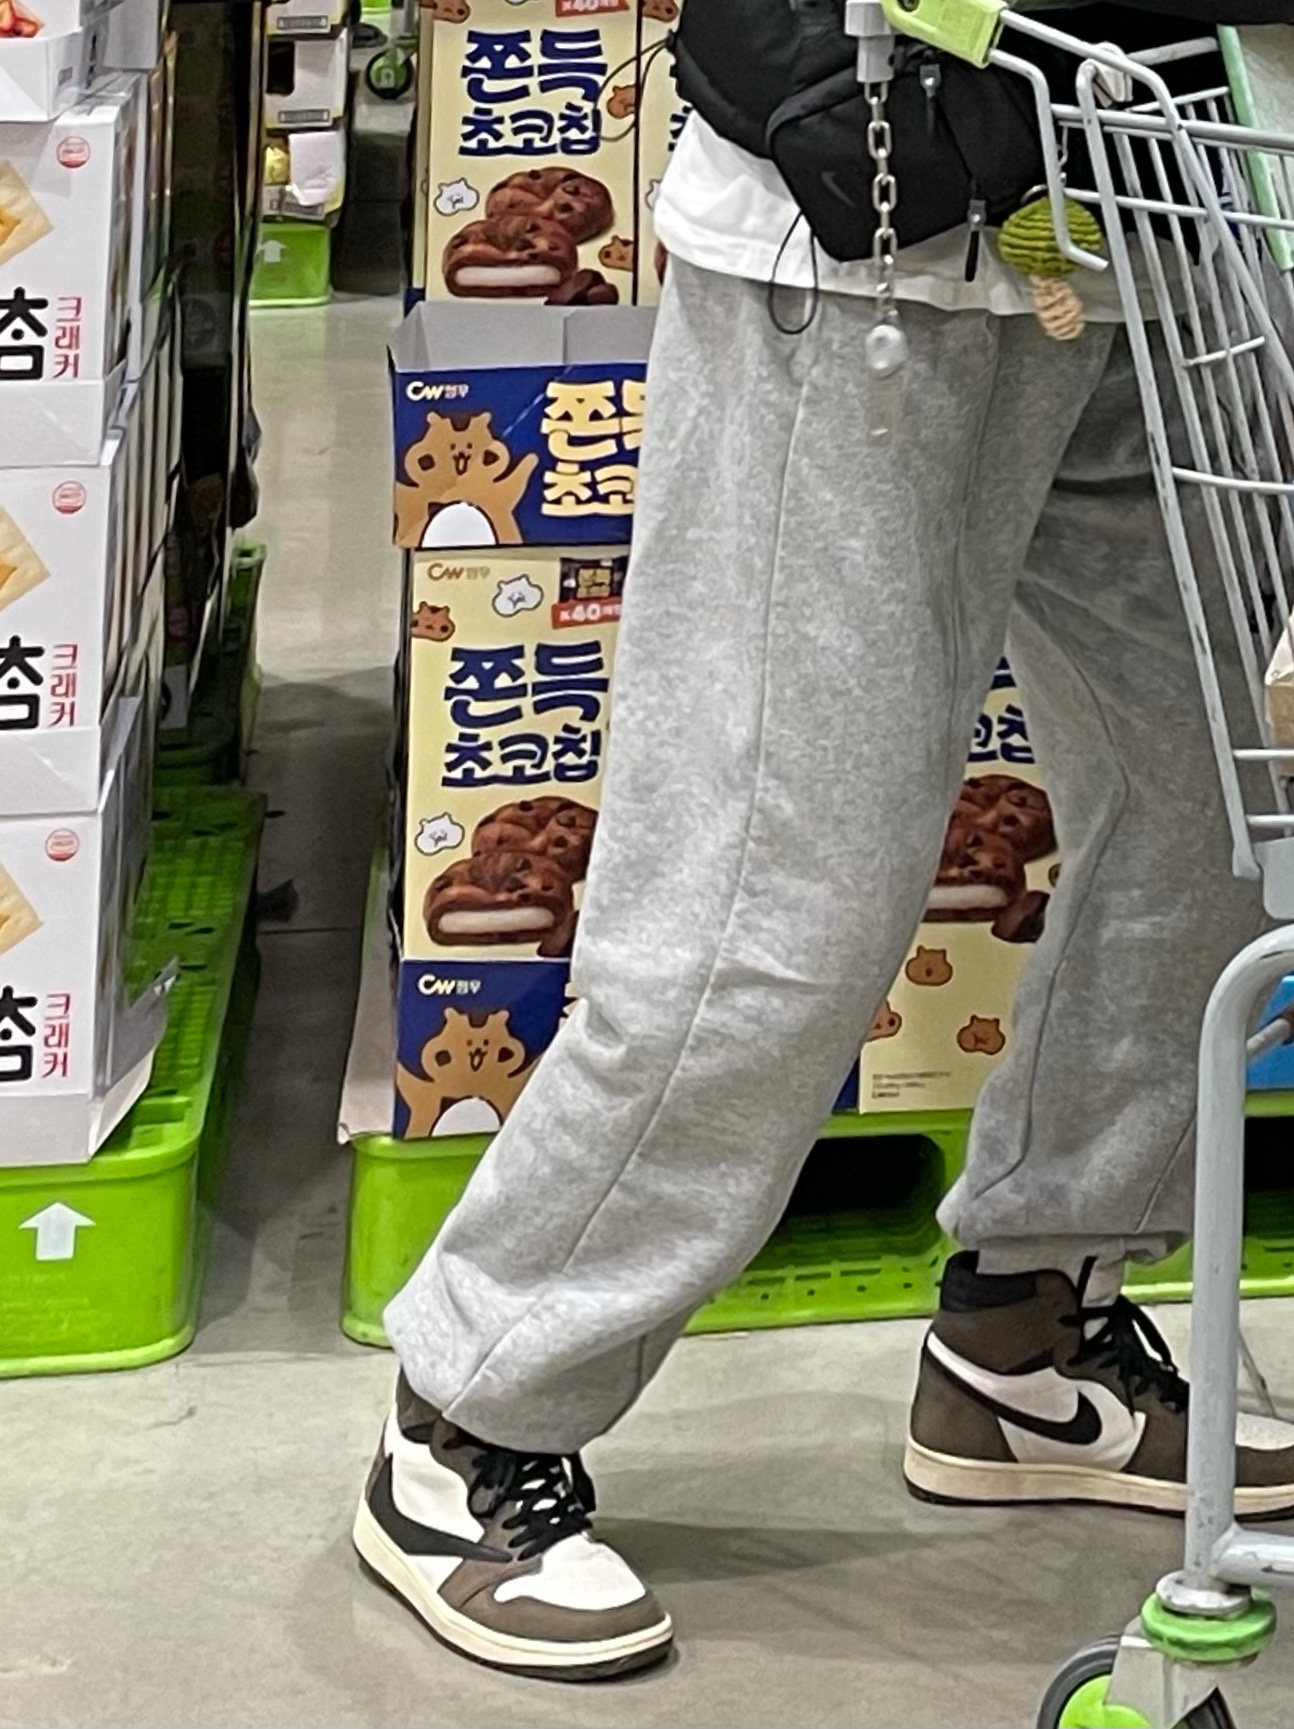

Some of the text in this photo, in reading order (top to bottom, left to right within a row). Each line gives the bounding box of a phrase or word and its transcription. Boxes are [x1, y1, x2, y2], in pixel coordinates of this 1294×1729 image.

[460, 29, 608, 104] 쫀득
[53, 295, 83, 379] 크래커
[49, 644, 79, 728] 크래커
[444, 640, 609, 730] 쫀득
[441, 722, 602, 787] 초코칩
[41, 992, 71, 1078] 크래커
